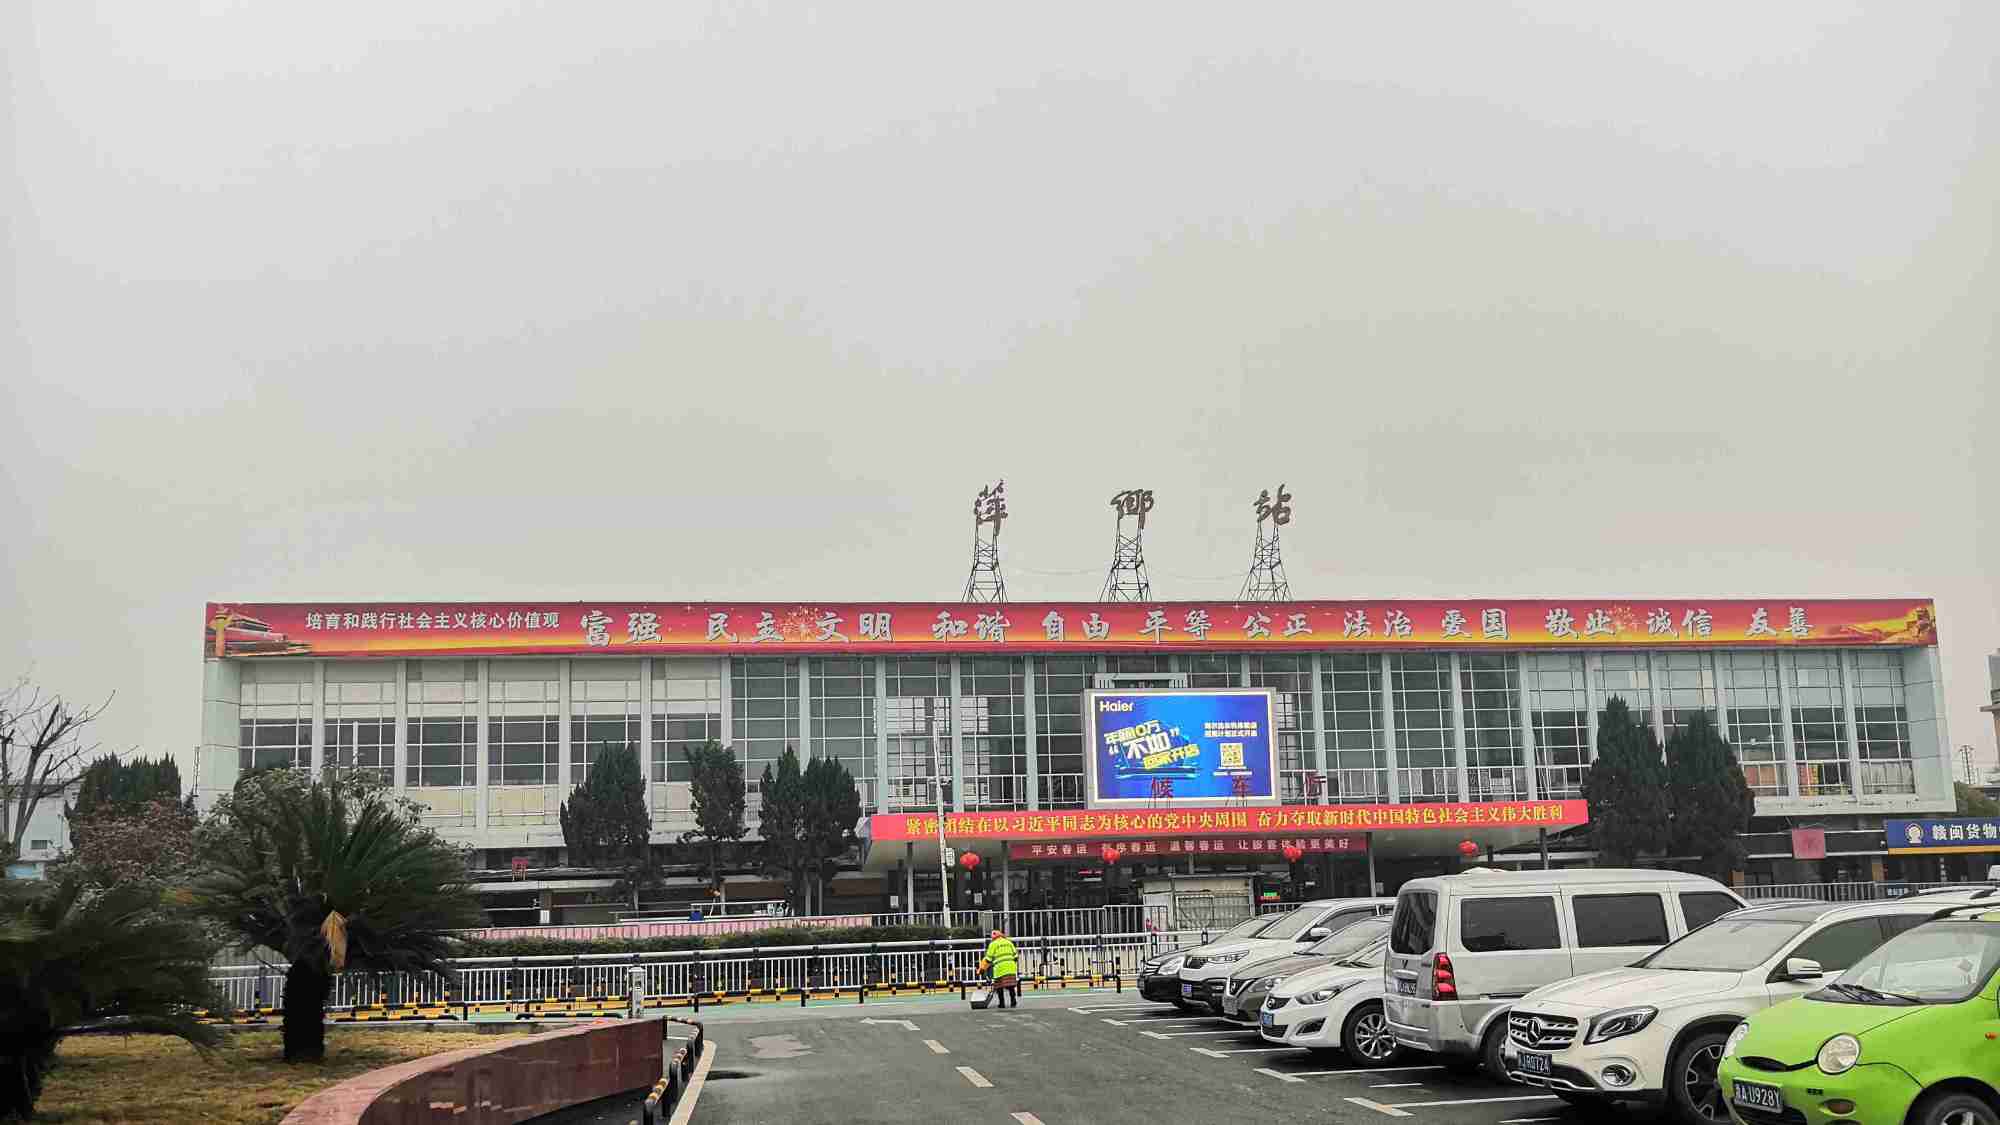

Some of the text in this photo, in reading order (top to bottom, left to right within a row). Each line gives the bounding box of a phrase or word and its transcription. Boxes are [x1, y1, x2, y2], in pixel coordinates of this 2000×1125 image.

[306, 607, 1815, 647] 培育和践行社会主义核心价值观 富强 民主 文明 和谐 自由 平等 公正 法治 爱国 敬业 诚信 友善
[1099, 700, 1134, 713] Haier
[905, 804, 1563, 834] 紧密团结在以习近平同志为核心的党中央周围 奋力夺取新时代中国特色社会主义伟大胜利
[1932, 823, 2000, 841] 赣闽货物
[1031, 844, 1088, 856] 平安春运
